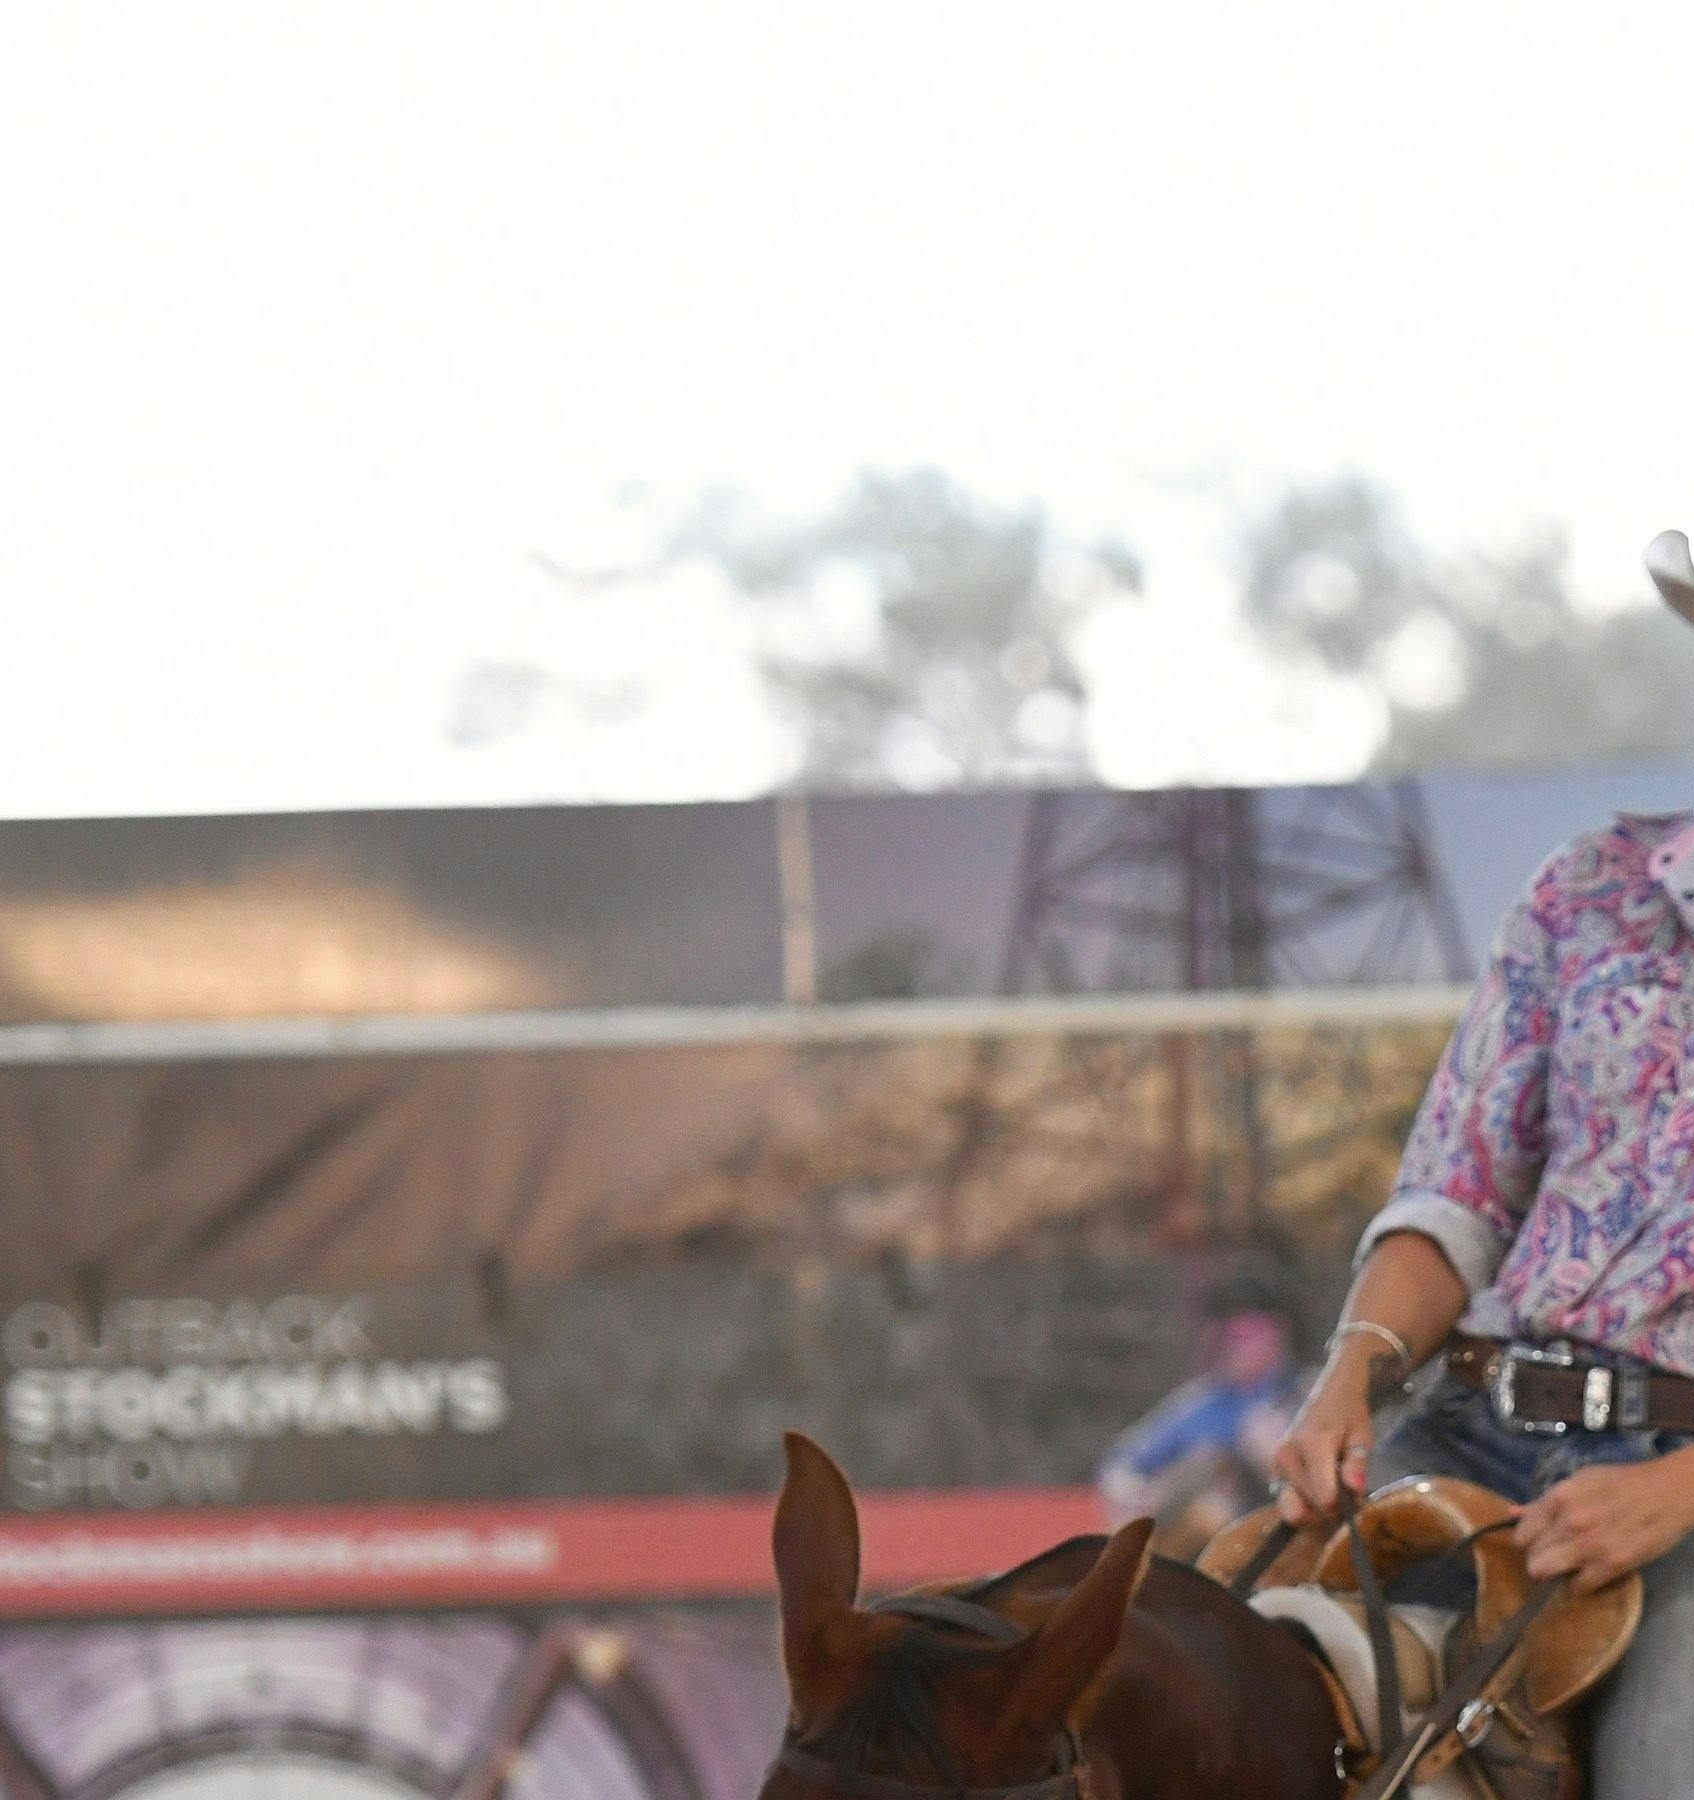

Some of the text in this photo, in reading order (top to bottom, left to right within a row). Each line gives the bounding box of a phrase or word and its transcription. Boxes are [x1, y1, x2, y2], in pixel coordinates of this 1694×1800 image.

[6, 1298, 374, 1366] OUTBACK
[6, 1361, 505, 1444] STOCKMAN'S
[8, 1441, 245, 1507] SHOW
